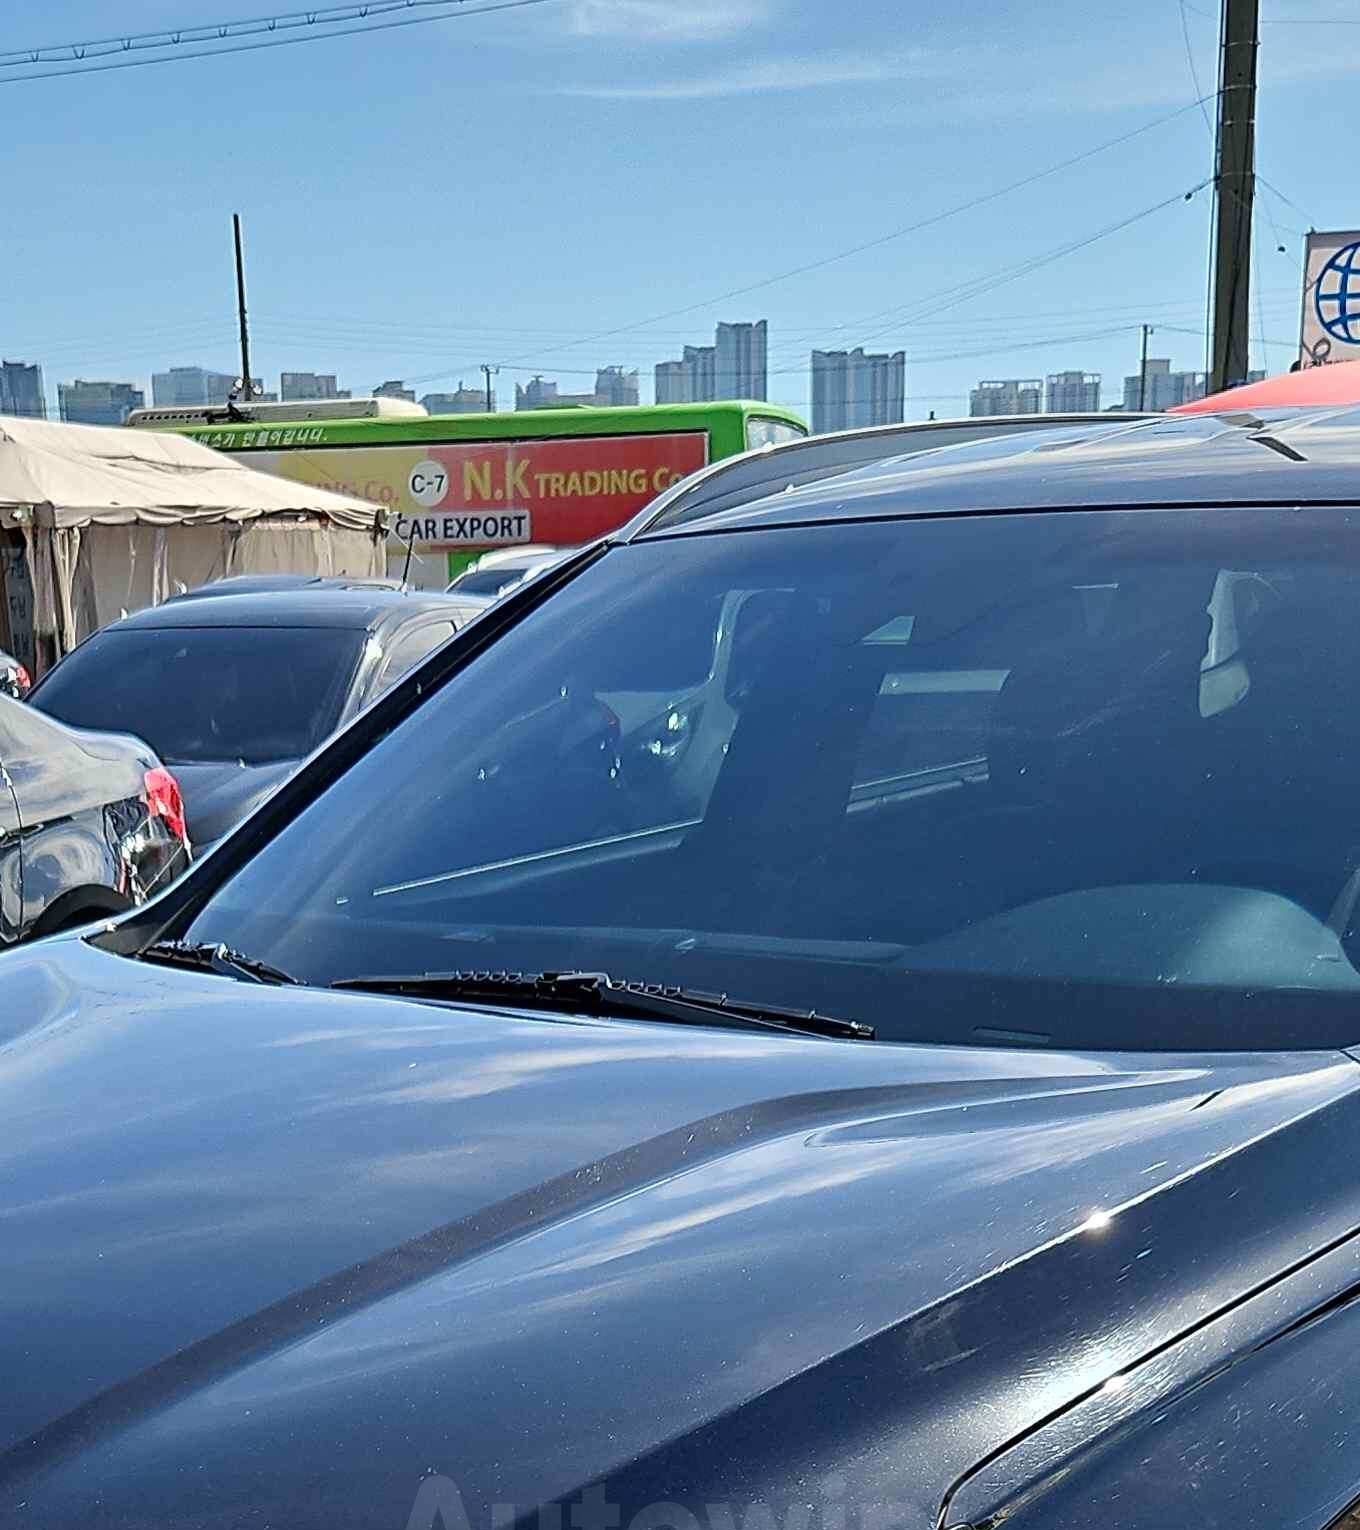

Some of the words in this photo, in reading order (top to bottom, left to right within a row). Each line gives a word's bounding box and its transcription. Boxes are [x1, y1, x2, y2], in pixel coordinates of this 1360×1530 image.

[411, 474, 445, 493] C-7
[534, 469, 648, 498] TRADING
[395, 520, 440, 541] CAR
[446, 516, 527, 539] EXPORT
